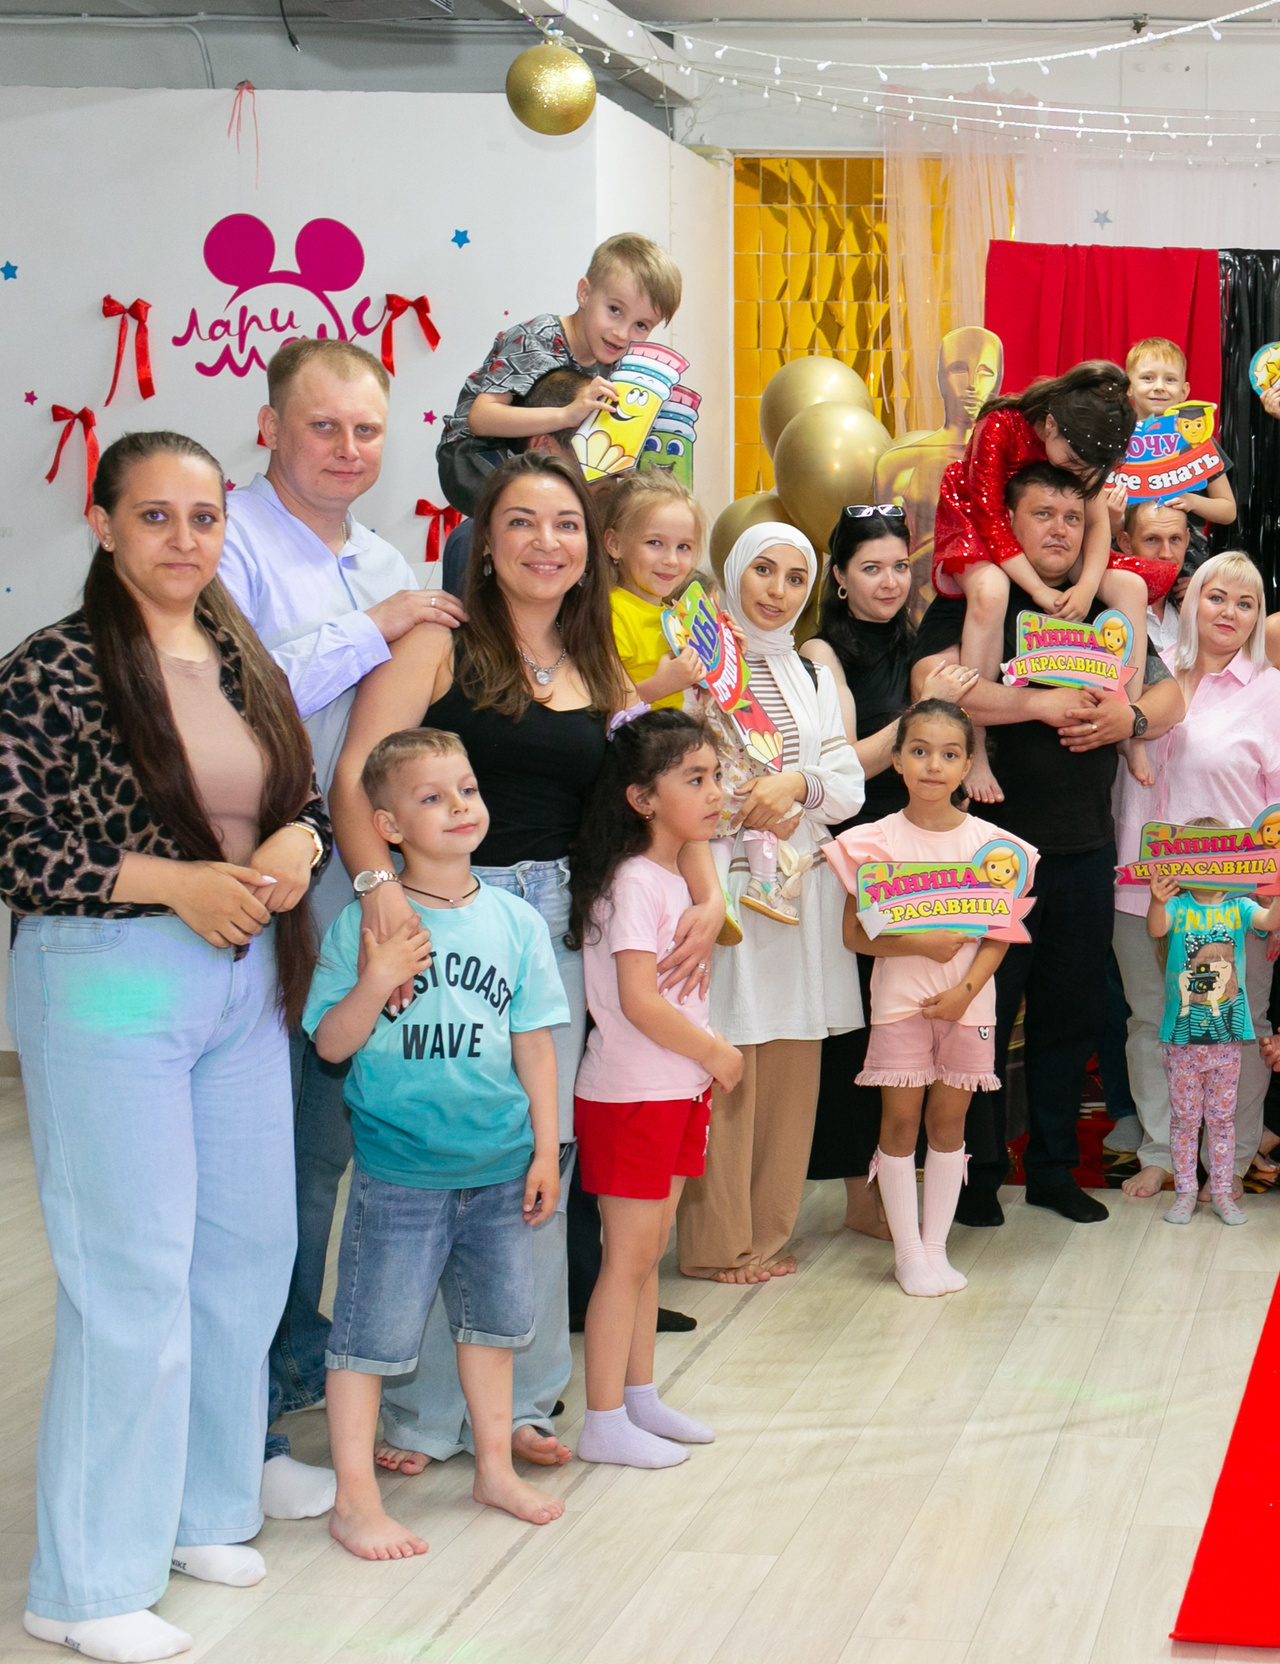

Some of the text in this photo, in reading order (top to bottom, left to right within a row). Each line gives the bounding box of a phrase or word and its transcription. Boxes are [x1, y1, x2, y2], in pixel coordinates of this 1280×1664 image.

[1126, 433, 1180, 458] ОЧУ
[1148, 453, 1220, 490] знать
[688, 599, 720, 673] МЫ
[1024, 628, 1098, 650] УМНИЦА
[1015, 655, 1118, 679] И КРАСАВИЦА
[1148, 833, 1255, 857] УМНИЦА
[1134, 858, 1277, 877] И КРАСАВИЦА
[865, 867, 980, 903] УМНИЦА
[445, 952, 513, 1017] COAST
[402, 1023, 484, 1060] WAVE
